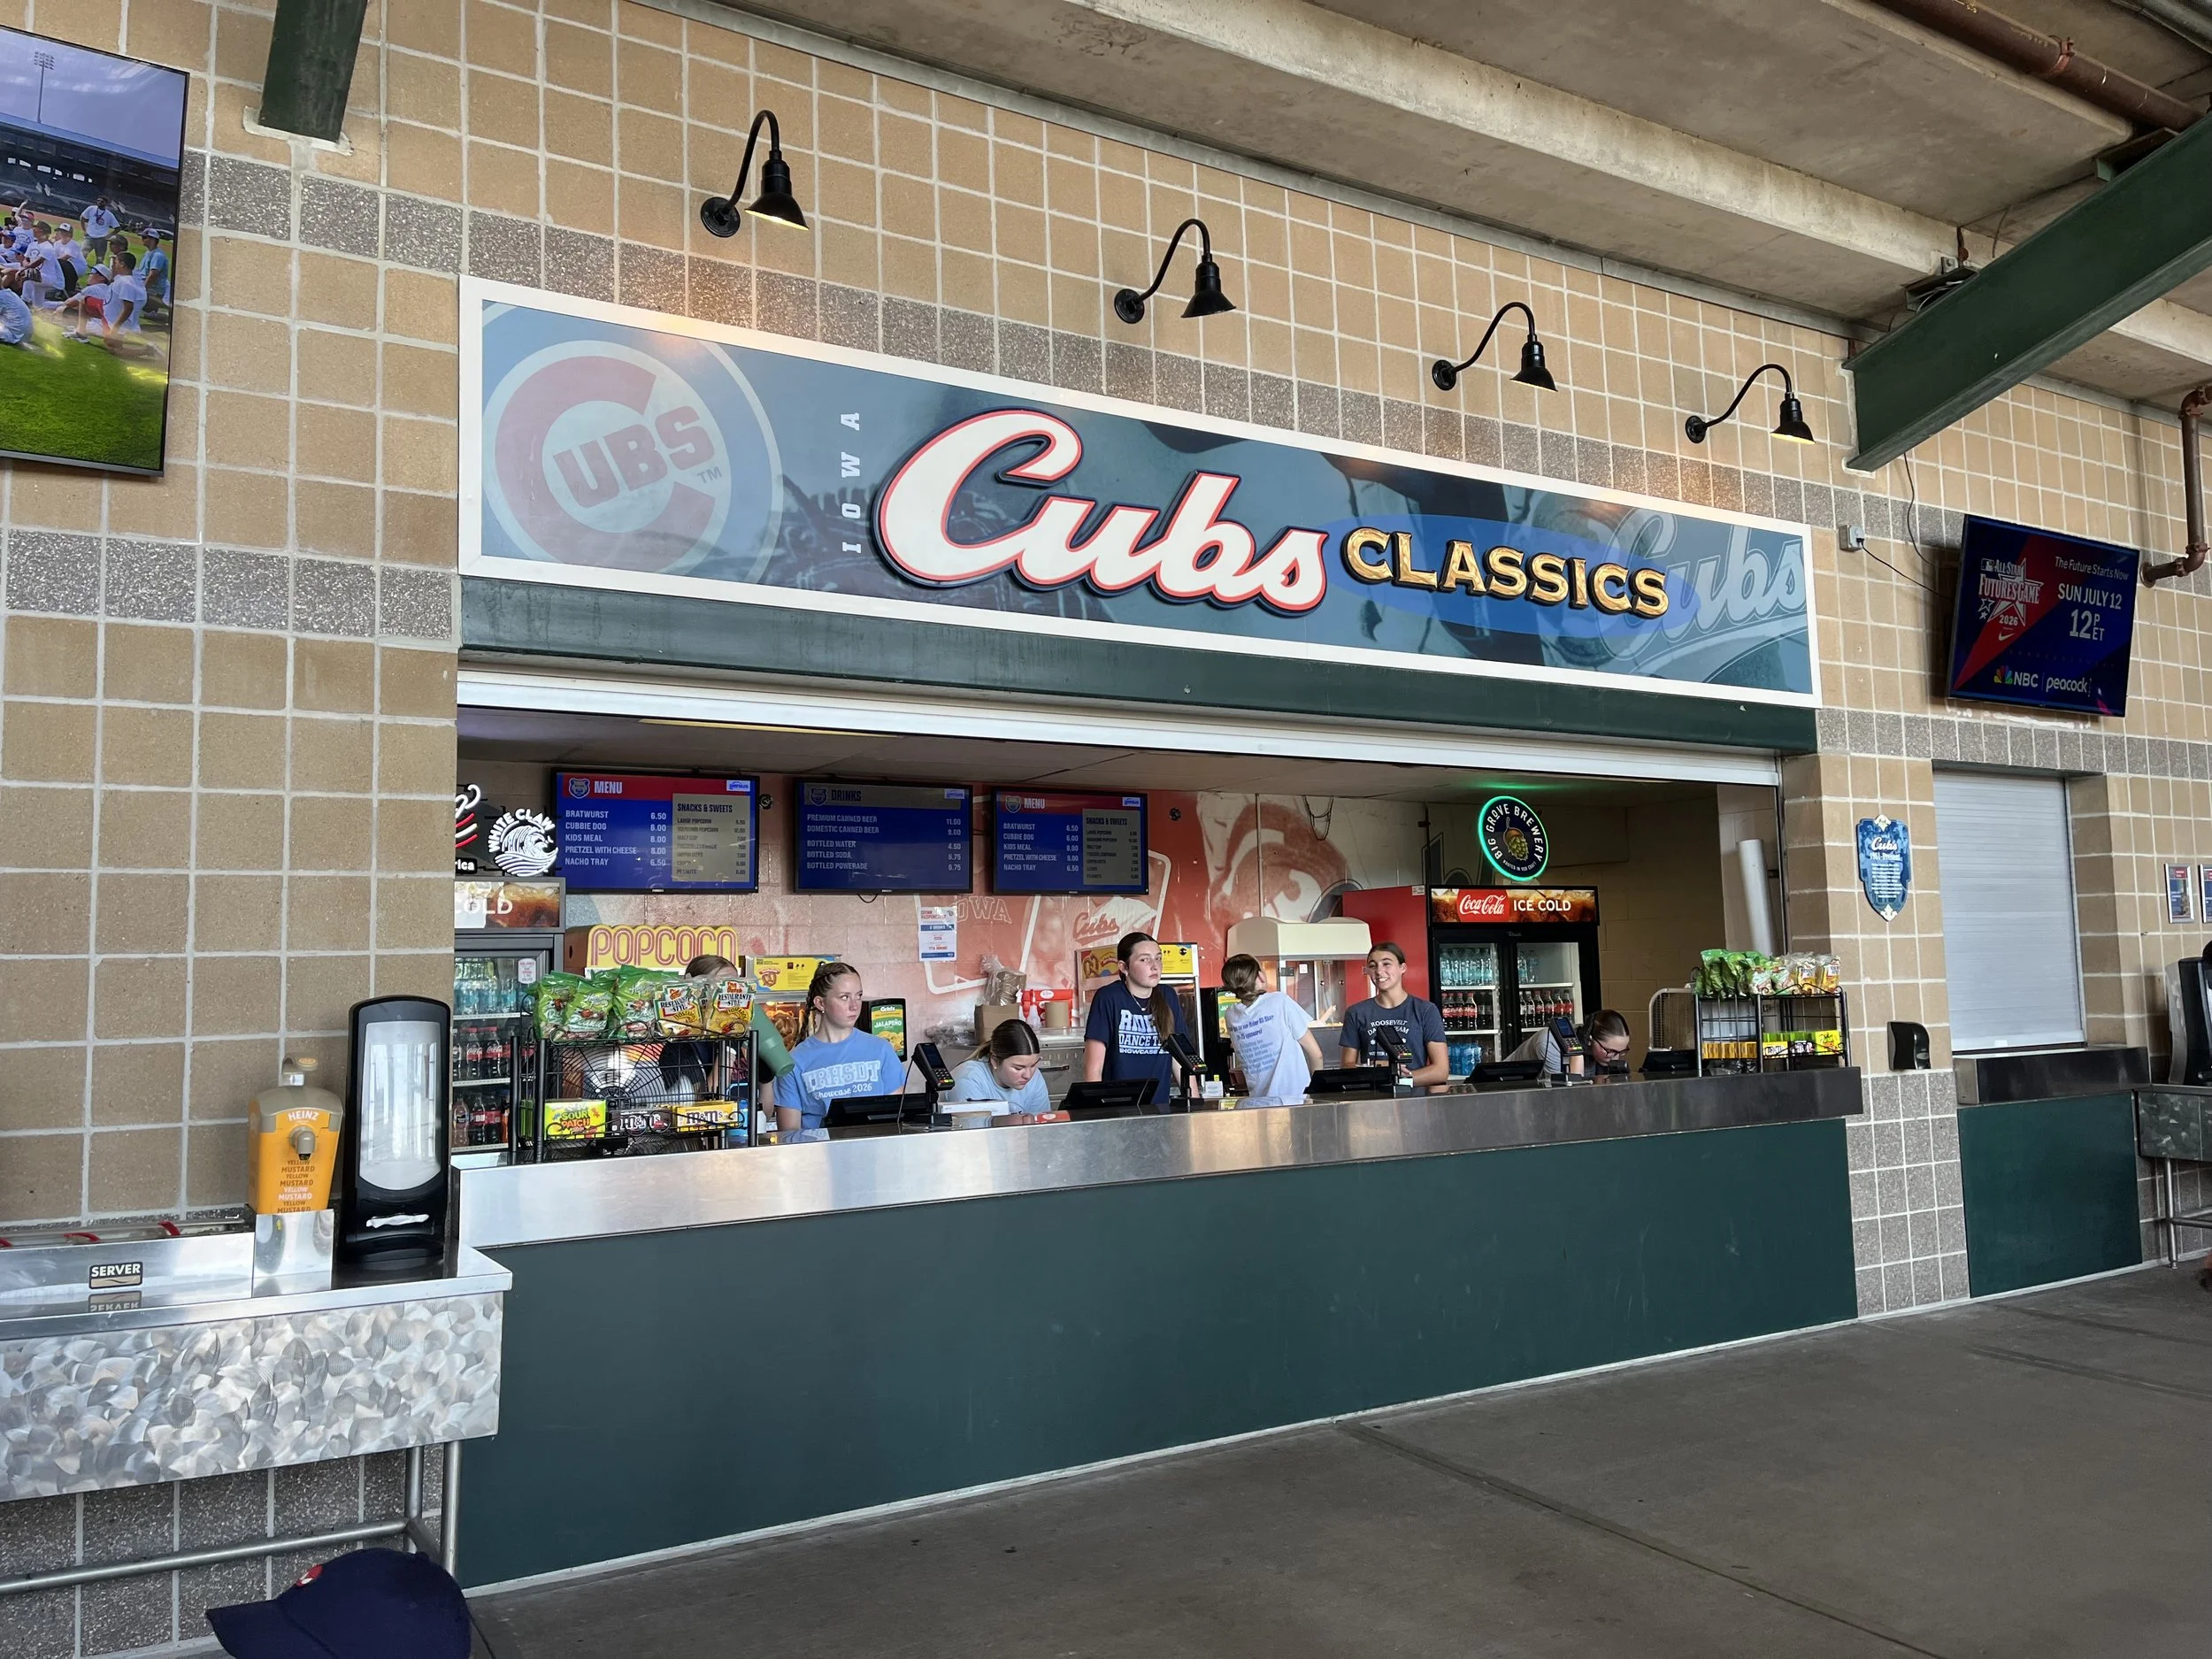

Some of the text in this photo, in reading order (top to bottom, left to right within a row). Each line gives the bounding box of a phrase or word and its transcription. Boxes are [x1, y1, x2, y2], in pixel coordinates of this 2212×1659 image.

[696, 465, 723, 484] TM
[839, 411, 864, 555] IOWA
[872, 407, 1331, 617] Cubs
[1342, 526, 1671, 620] CLASSICS
[2055, 556, 2130, 581] The Future Starts Now
[1978, 573, 2041, 604] FUTURES GAME
[2057, 583, 2123, 610] SUN JULY 12
[1999, 614, 2019, 626] 2026
[2070, 609, 2101, 639] 12 P
[2093, 626, 2105, 641] ET
[2014, 671, 2088, 693] NBC peacock
[595, 780, 623, 795] MENU
[832, 789, 862, 802] DRINKS
[677, 803, 703, 812] SNACKS
[709, 804, 733, 813] SWEETS
[1024, 797, 1045, 810] MENU
[565, 810, 609, 819] BRATWURST
[488, 808, 556, 853] WHITE CLAW
[1486, 803, 1544, 863] BIG GROVE BREWERY
[1871, 836, 1898, 851] Cubs
[1459, 895, 1571, 915] Coca-Cola ICE COLD
[1072, 911, 1120, 940] Cubs
[874, 1018, 902, 1028] JALAPEÑO
[1118, 1033, 1151, 1046] DANCE
[852, 1083, 872, 1093] 2026
[288, 1110, 319, 1121] HEINZ
[562, 1110, 589, 1120] SOUR
[561, 1118, 590, 1128] PATCH
[91, 1263, 141, 1278] SERVER
